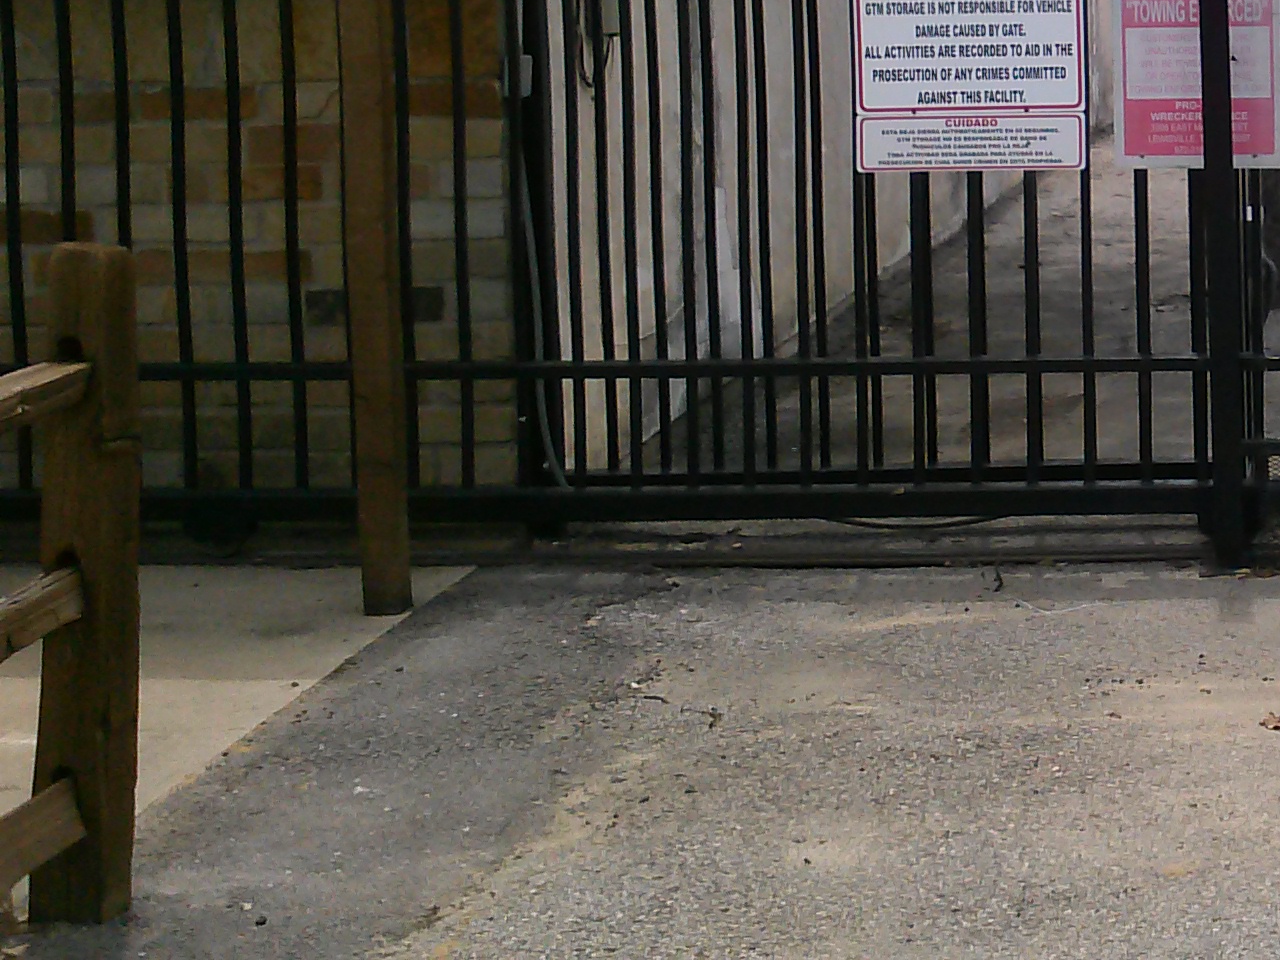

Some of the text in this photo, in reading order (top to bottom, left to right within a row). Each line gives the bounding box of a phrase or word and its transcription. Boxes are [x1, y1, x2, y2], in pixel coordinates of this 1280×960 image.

[865, 0, 1072, 16] GTM STORAGE IS NOT RESPONSIBLE FOR VEHICLE
[915, 23, 1026, 38] DAMAGE CAUSED BY GATE.
[865, 43, 1073, 59] ALL ACTIVITIES ARE RECORDED TO AID IN THE
[872, 66, 1067, 83] PROSECUTION OF ANY CRIMES COMMITTED
[917, 90, 1026, 105] AGAINST THIS FACILITY.
[945, 118, 998, 128] CUIDADO
[1151, 112, 1202, 121] WRECKER
